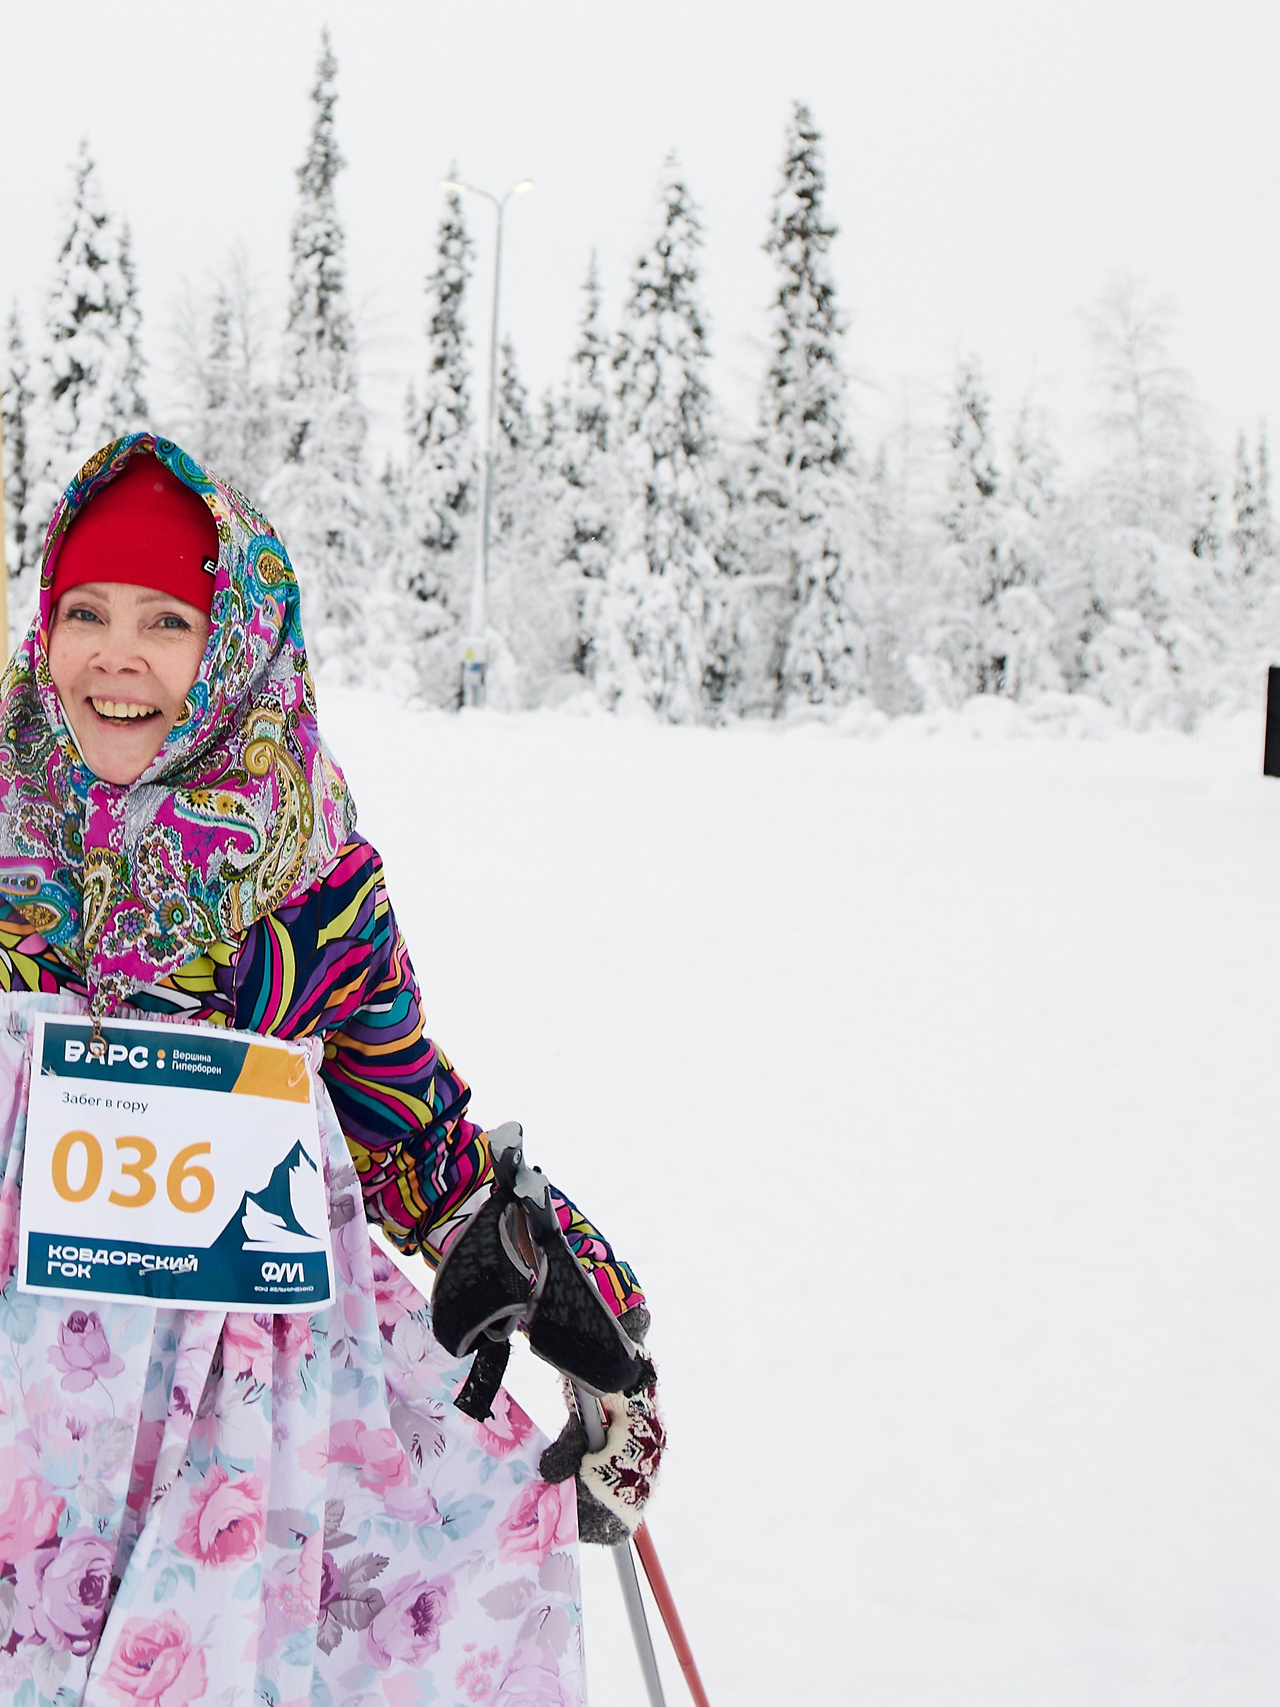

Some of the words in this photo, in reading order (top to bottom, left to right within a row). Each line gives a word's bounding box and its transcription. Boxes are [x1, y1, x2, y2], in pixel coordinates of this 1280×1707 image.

[172, 1049, 212, 1062] Вершина
[171, 1060, 222, 1075] Гипербореи
[62, 1091, 102, 1106] Забег
[105, 1098, 113, 1108] в
[116, 1099, 149, 1114] гору
[51, 1129, 216, 1214] 036
[48, 1244, 199, 1272] КОВДОРСКИЙ
[47, 1260, 92, 1279] ГОК
